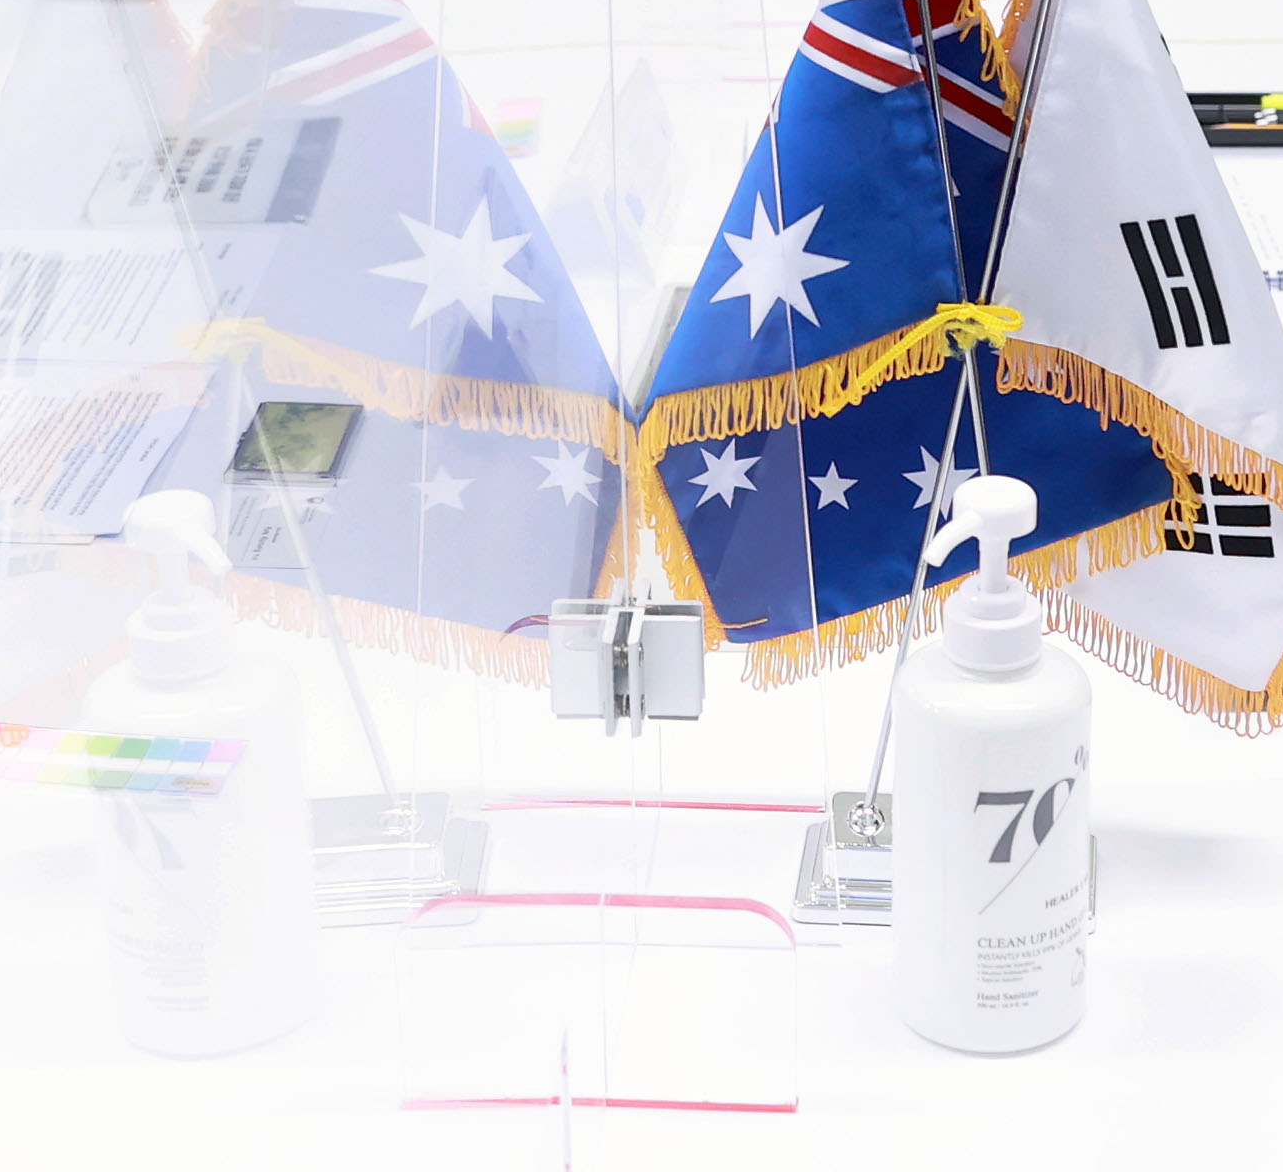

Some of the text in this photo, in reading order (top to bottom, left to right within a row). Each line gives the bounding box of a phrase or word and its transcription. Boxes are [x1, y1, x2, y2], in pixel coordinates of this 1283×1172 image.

[977, 933, 1027, 949] CLEAN
[1030, 931, 1048, 945] UP
[1049, 915, 1078, 940] HAND
